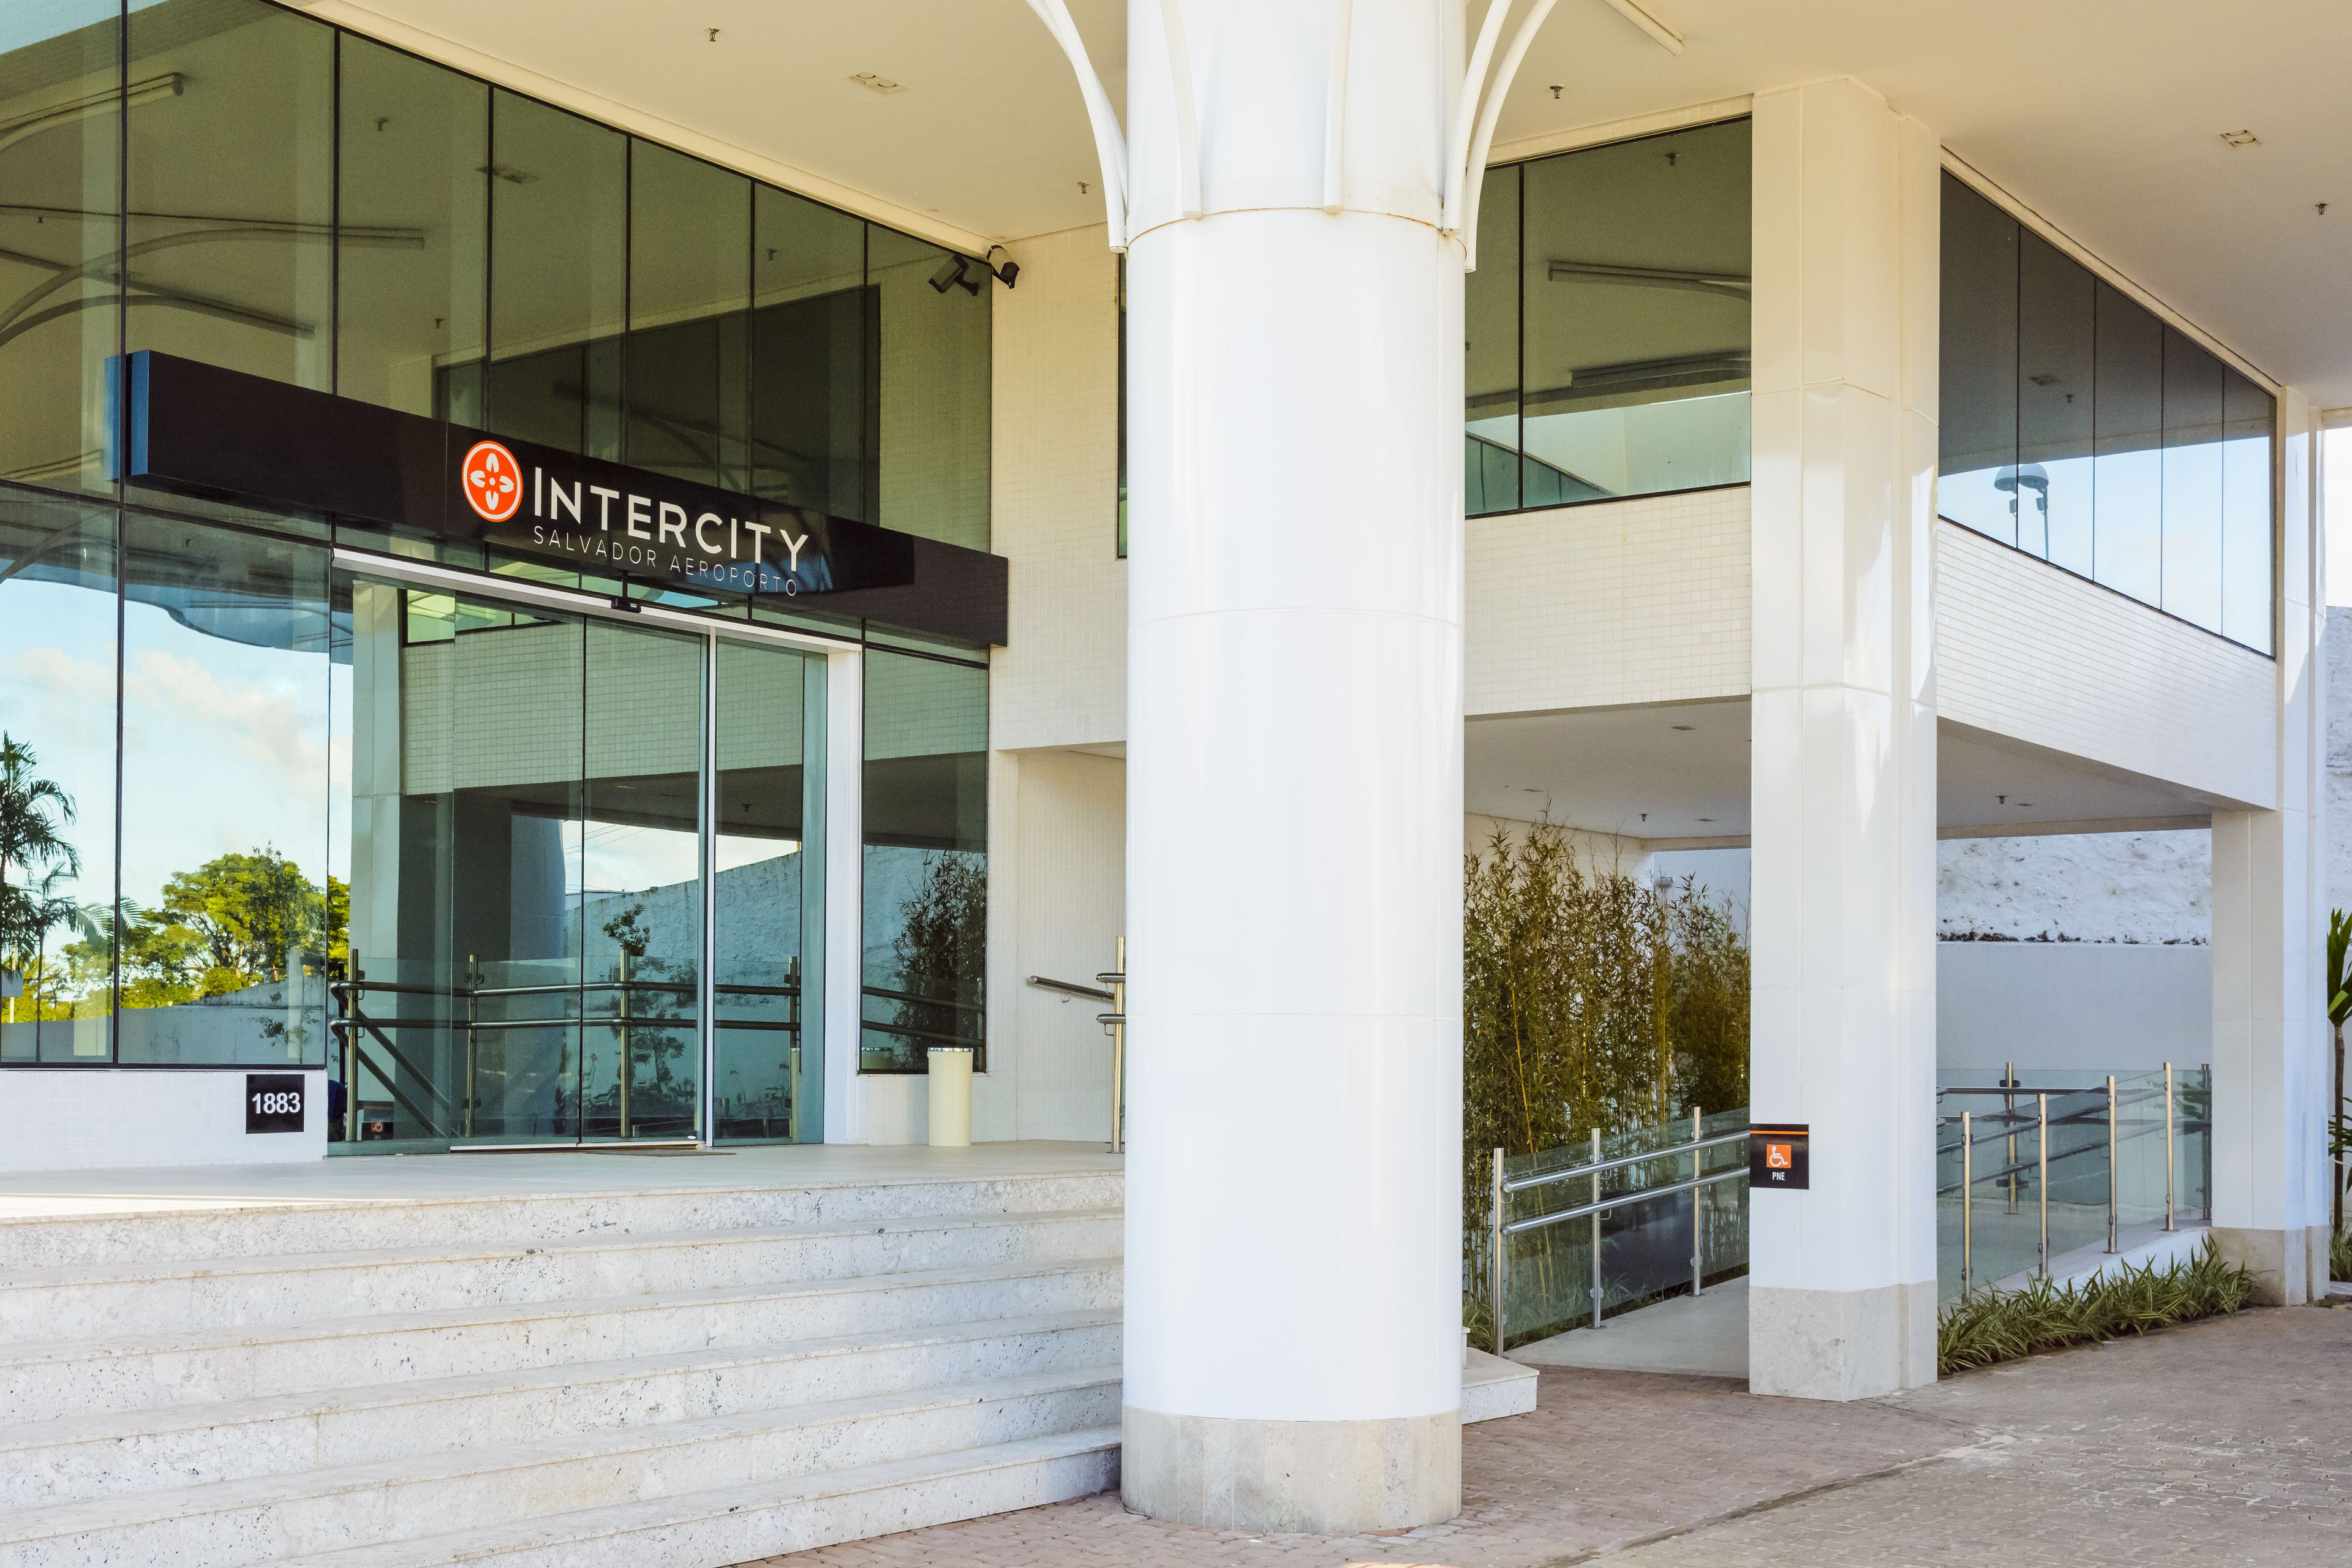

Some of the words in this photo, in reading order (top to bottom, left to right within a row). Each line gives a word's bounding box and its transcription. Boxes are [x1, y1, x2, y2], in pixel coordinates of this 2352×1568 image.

[535, 467, 809, 571] INTERCITY
[533, 526, 657, 567] SALVADOR
[669, 555, 797, 597] AEROPORTO
[252, 1092, 301, 1114] 1883
[1772, 1171, 1785, 1180] PNE
